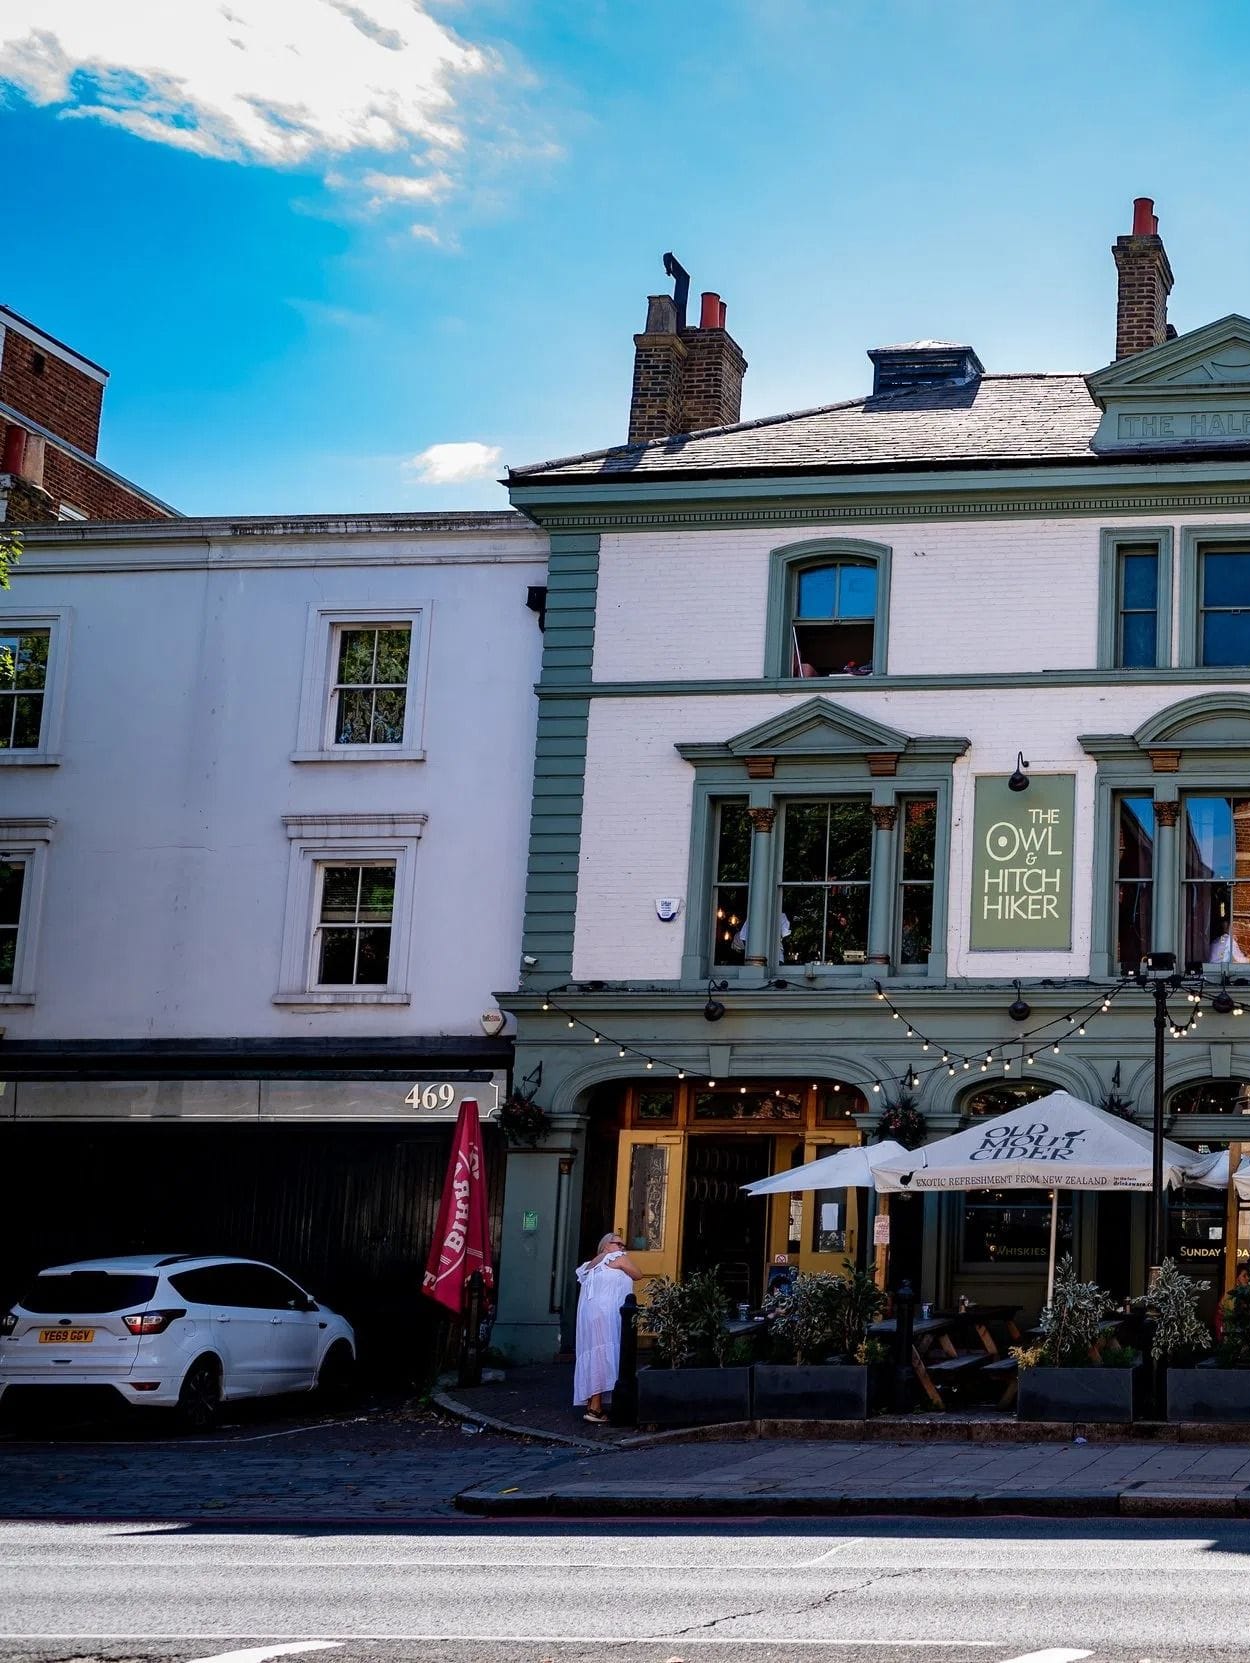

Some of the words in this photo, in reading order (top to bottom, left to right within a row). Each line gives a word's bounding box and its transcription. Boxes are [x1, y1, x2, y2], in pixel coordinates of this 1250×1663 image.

[1124, 416, 1174, 437] THE
[1028, 809, 1060, 824] THE
[986, 822, 1063, 861] OWL
[1025, 852, 1037, 865] &
[984, 868, 1060, 893] HITCH
[983, 895, 1059, 919] HIKER
[404, 1083, 455, 1110] 469
[984, 1123, 1049, 1138] OLD
[978, 1135, 1086, 1150] MOUT
[968, 1147, 1075, 1161] CIDER
[916, 1179, 946, 1187] EXOTIC
[949, 1176, 1012, 1186] REFRESHMENT
[1016, 1175, 1040, 1184] FROM
[1042, 1176, 1063, 1184] NEW
[1065, 1176, 1107, 1185] ZEALAND
[997, 1245, 1047, 1256] WHISKIES
[1180, 1246, 1221, 1257] SUNDAY
